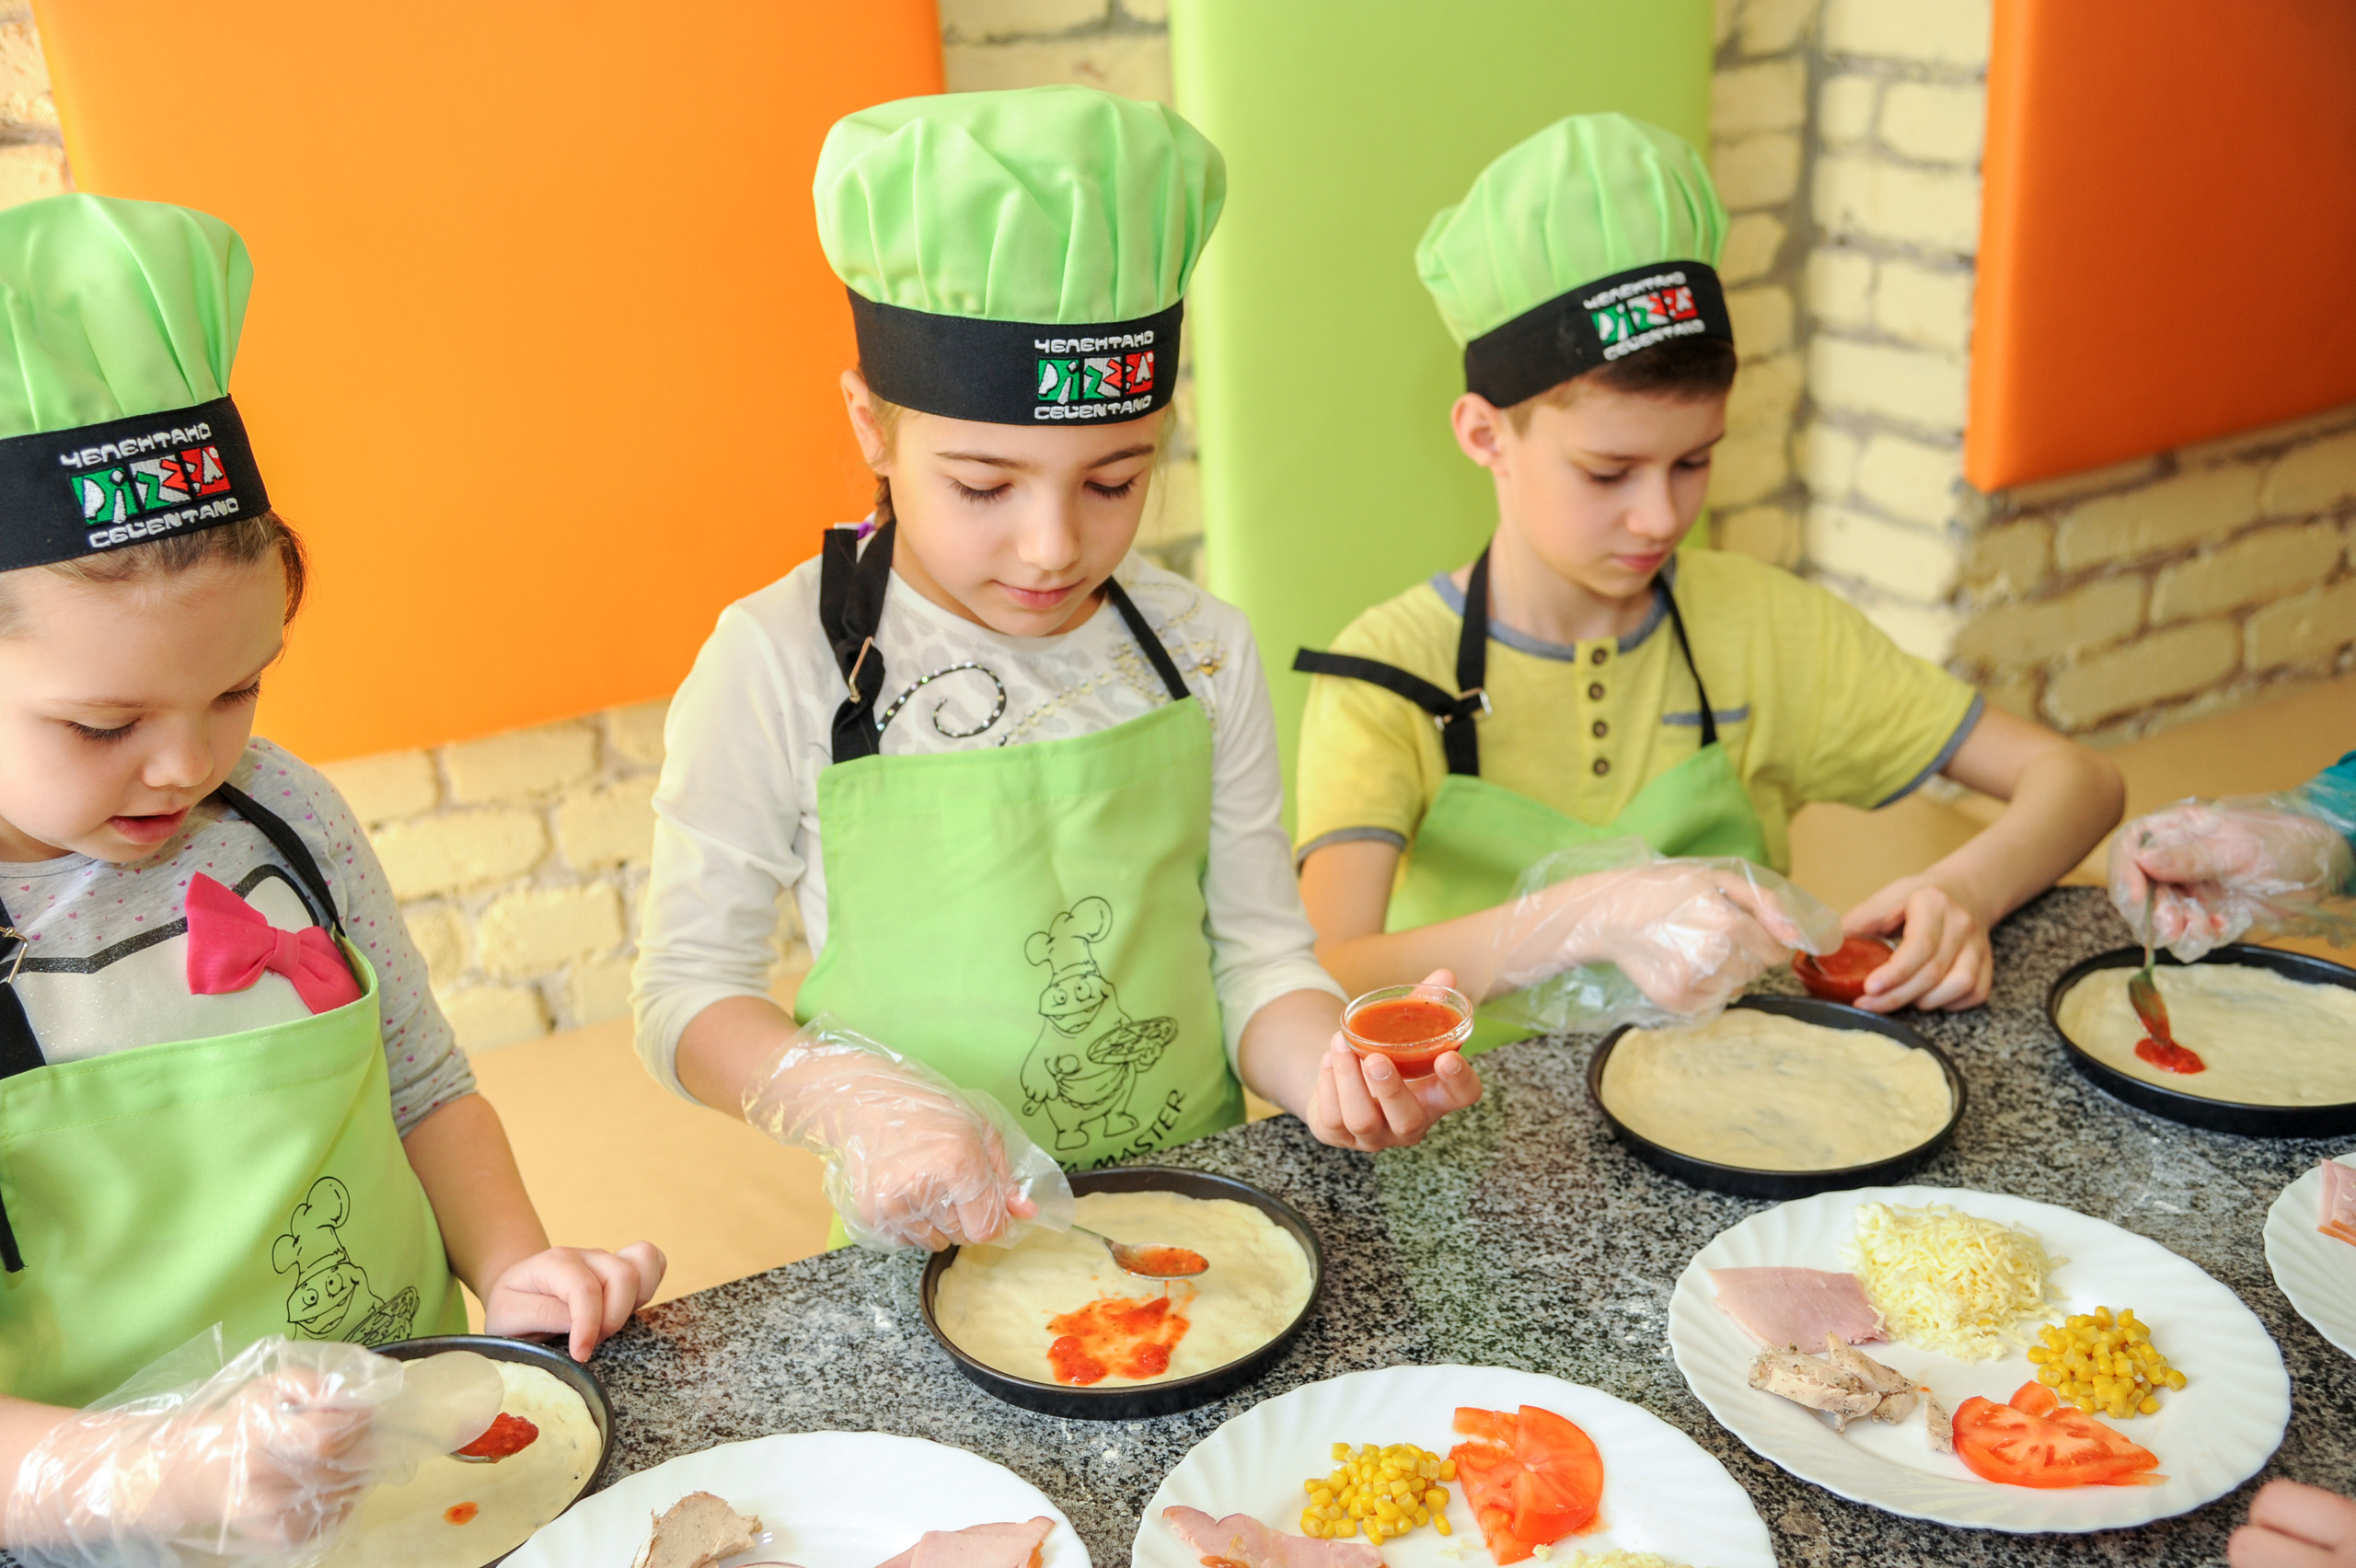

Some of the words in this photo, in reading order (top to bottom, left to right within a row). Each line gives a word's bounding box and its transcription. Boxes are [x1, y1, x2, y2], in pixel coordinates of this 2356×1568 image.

[1034, 329, 1155, 354] ЧЕЛЕНТАНО
[1034, 394, 1153, 421] CELENTANO
[59, 421, 213, 468] ЧЕЛЕНТАНО
[88, 497, 240, 548] CELENTANO
